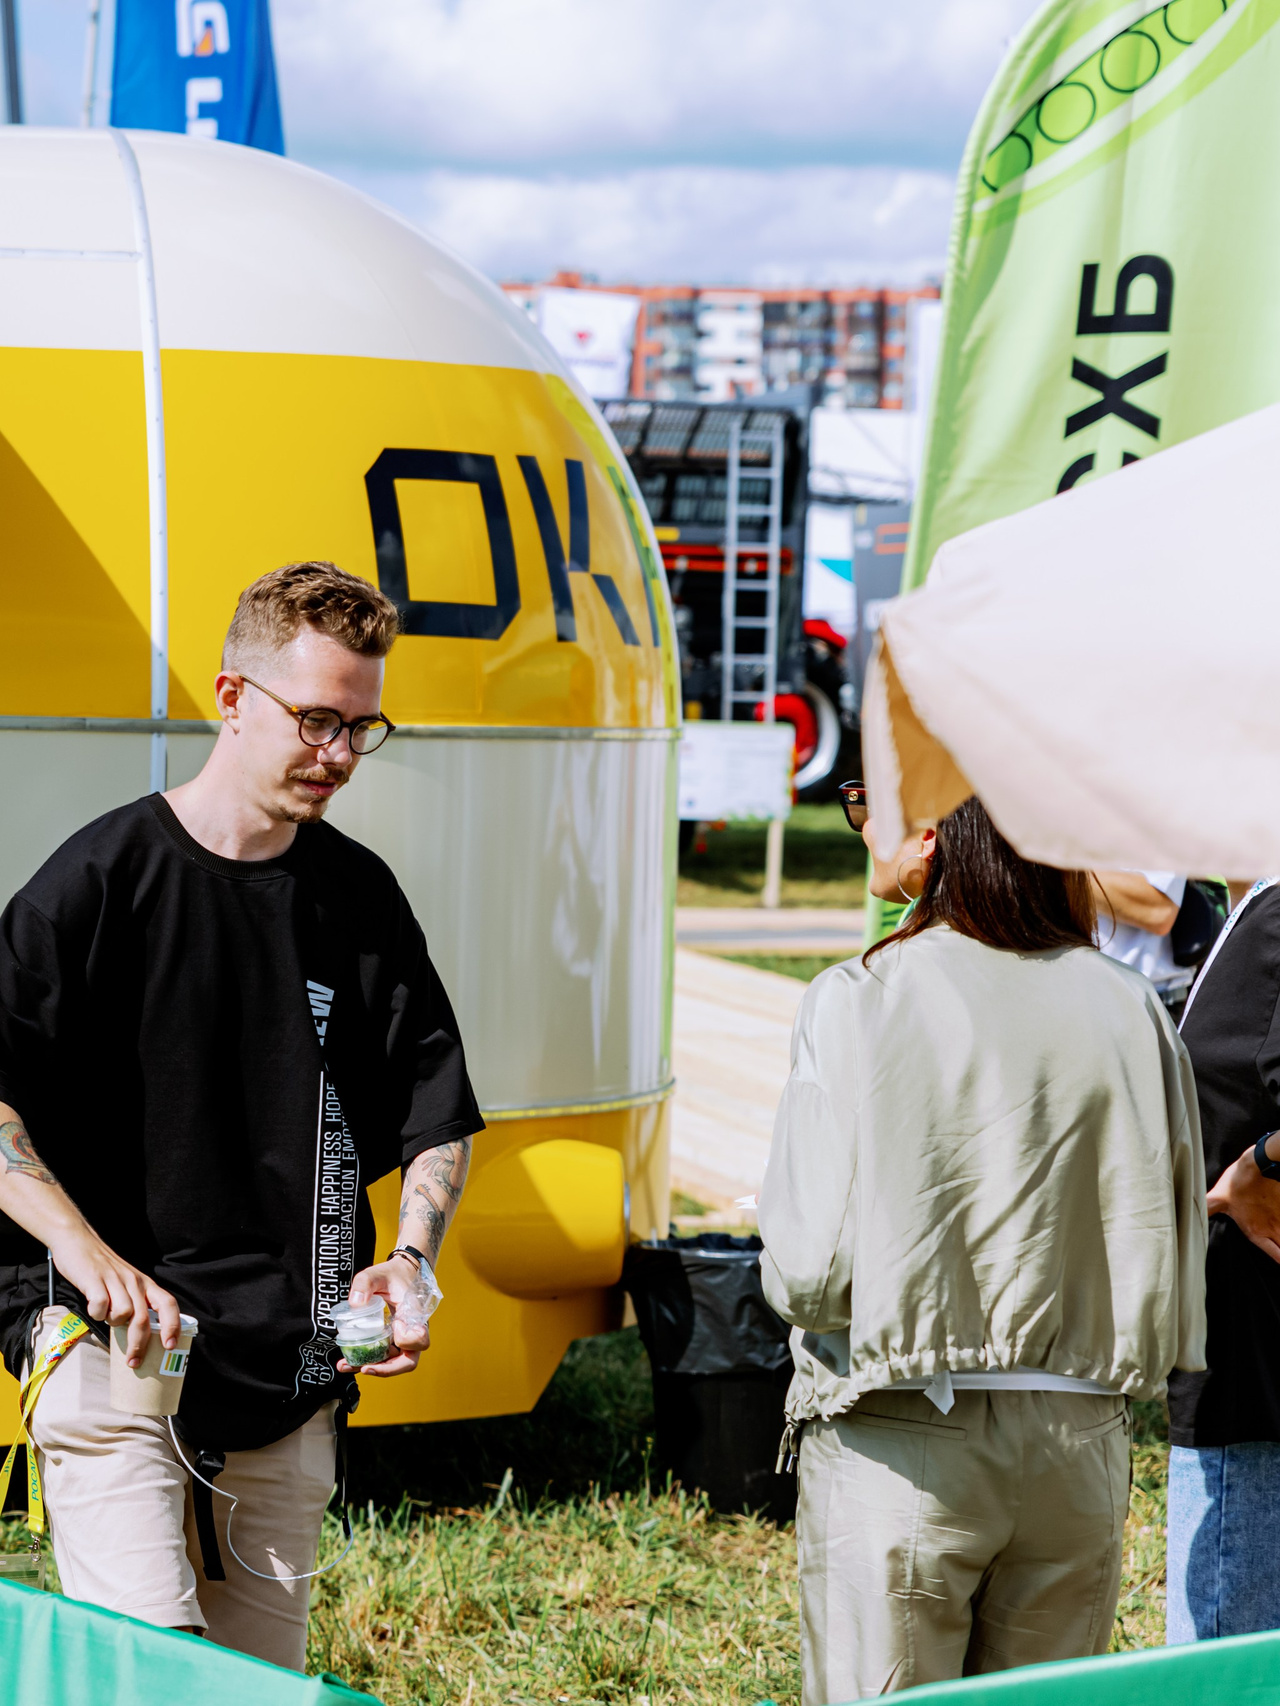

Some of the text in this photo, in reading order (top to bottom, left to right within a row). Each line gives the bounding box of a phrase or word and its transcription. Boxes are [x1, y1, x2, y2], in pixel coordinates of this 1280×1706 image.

[364, 447, 660, 648] ОК
[320, 1131, 342, 1215] HAPPINESS
[340, 1169, 355, 1271] SATISFACTION
[317, 1224, 340, 1330] EXPECTATIONS
